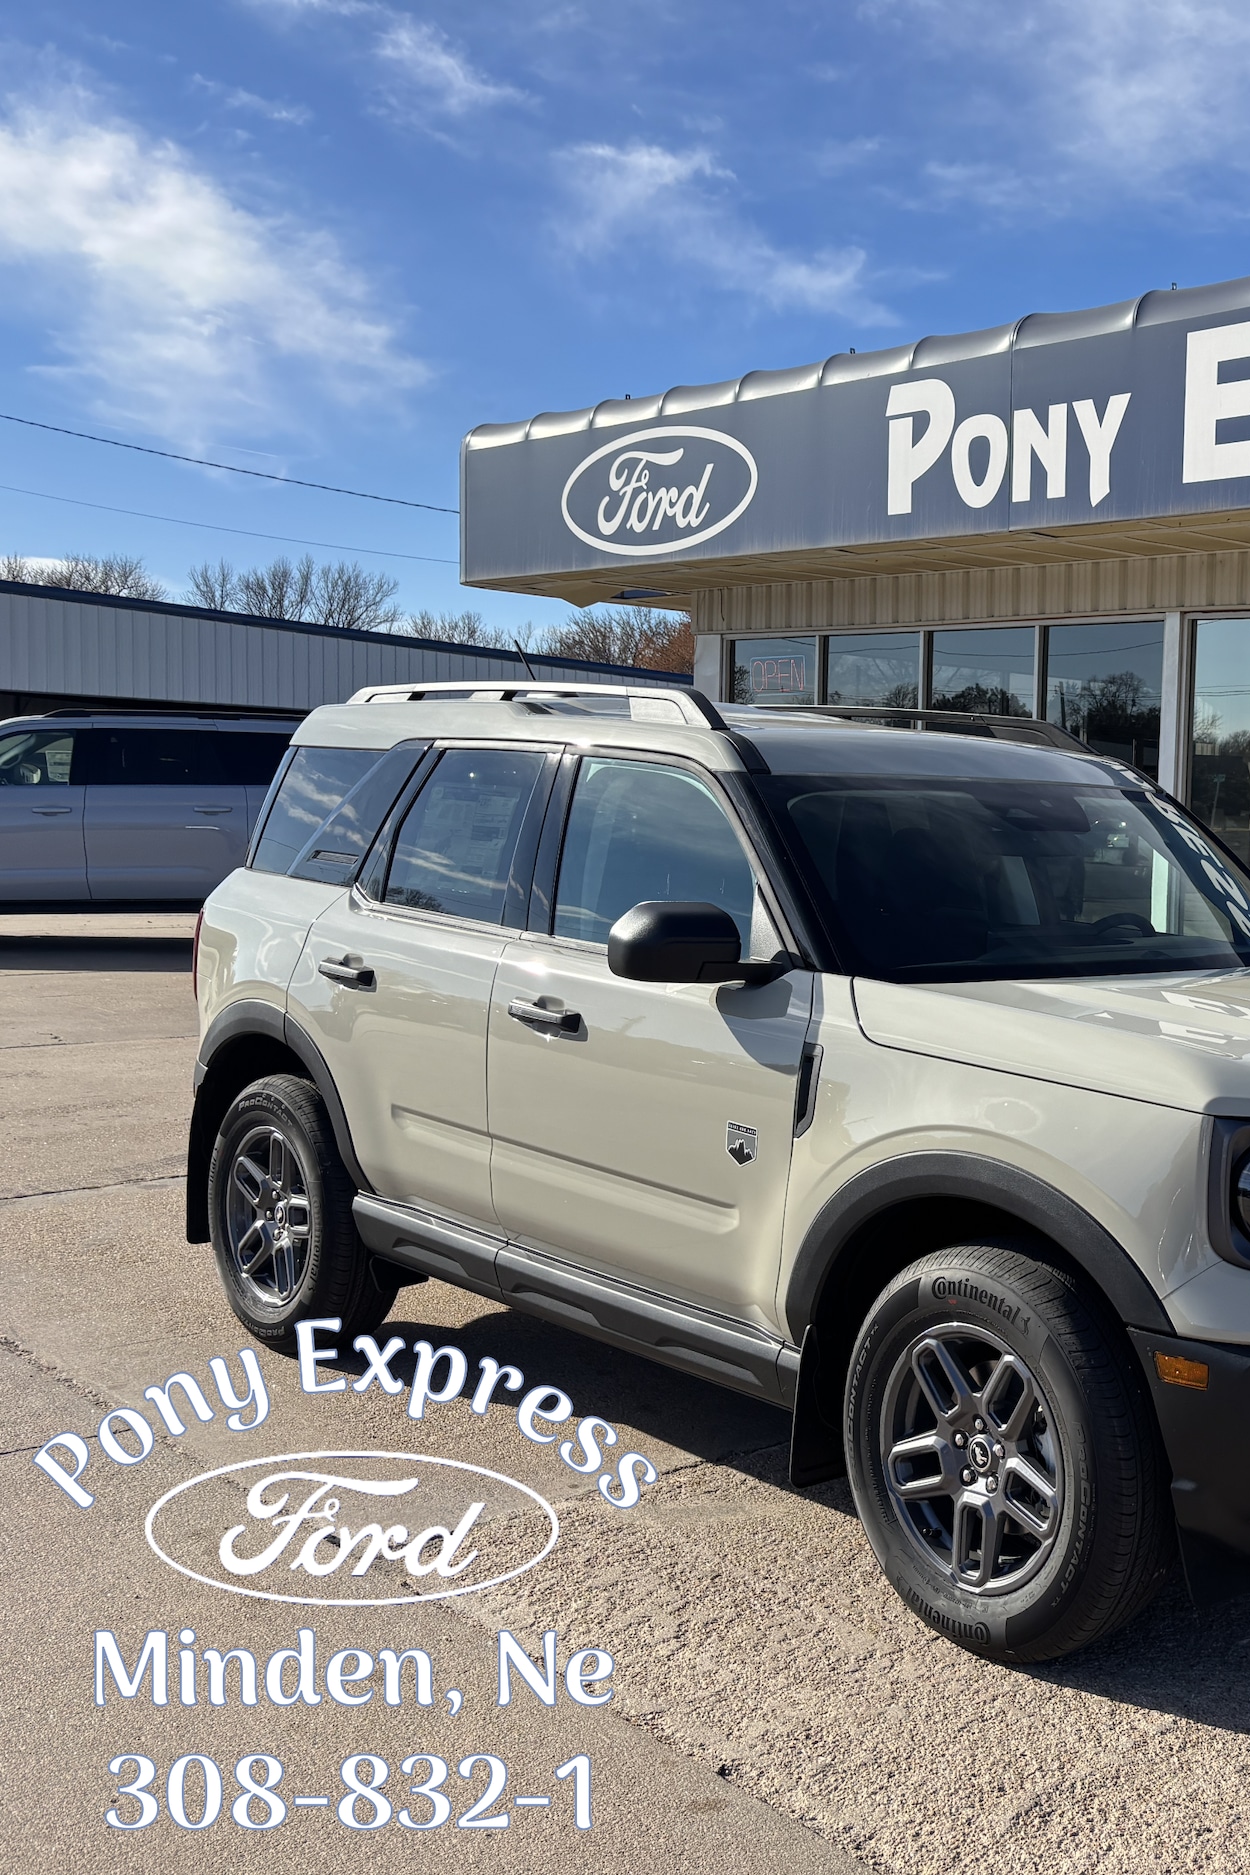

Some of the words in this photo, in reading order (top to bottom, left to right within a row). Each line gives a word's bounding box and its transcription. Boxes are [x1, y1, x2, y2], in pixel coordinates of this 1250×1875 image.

[598, 447, 714, 536] Ford
[752, 659, 804, 693] OPEN
[931, 1276, 1022, 1326] Continental
[905, 1586, 991, 1645] Continental
